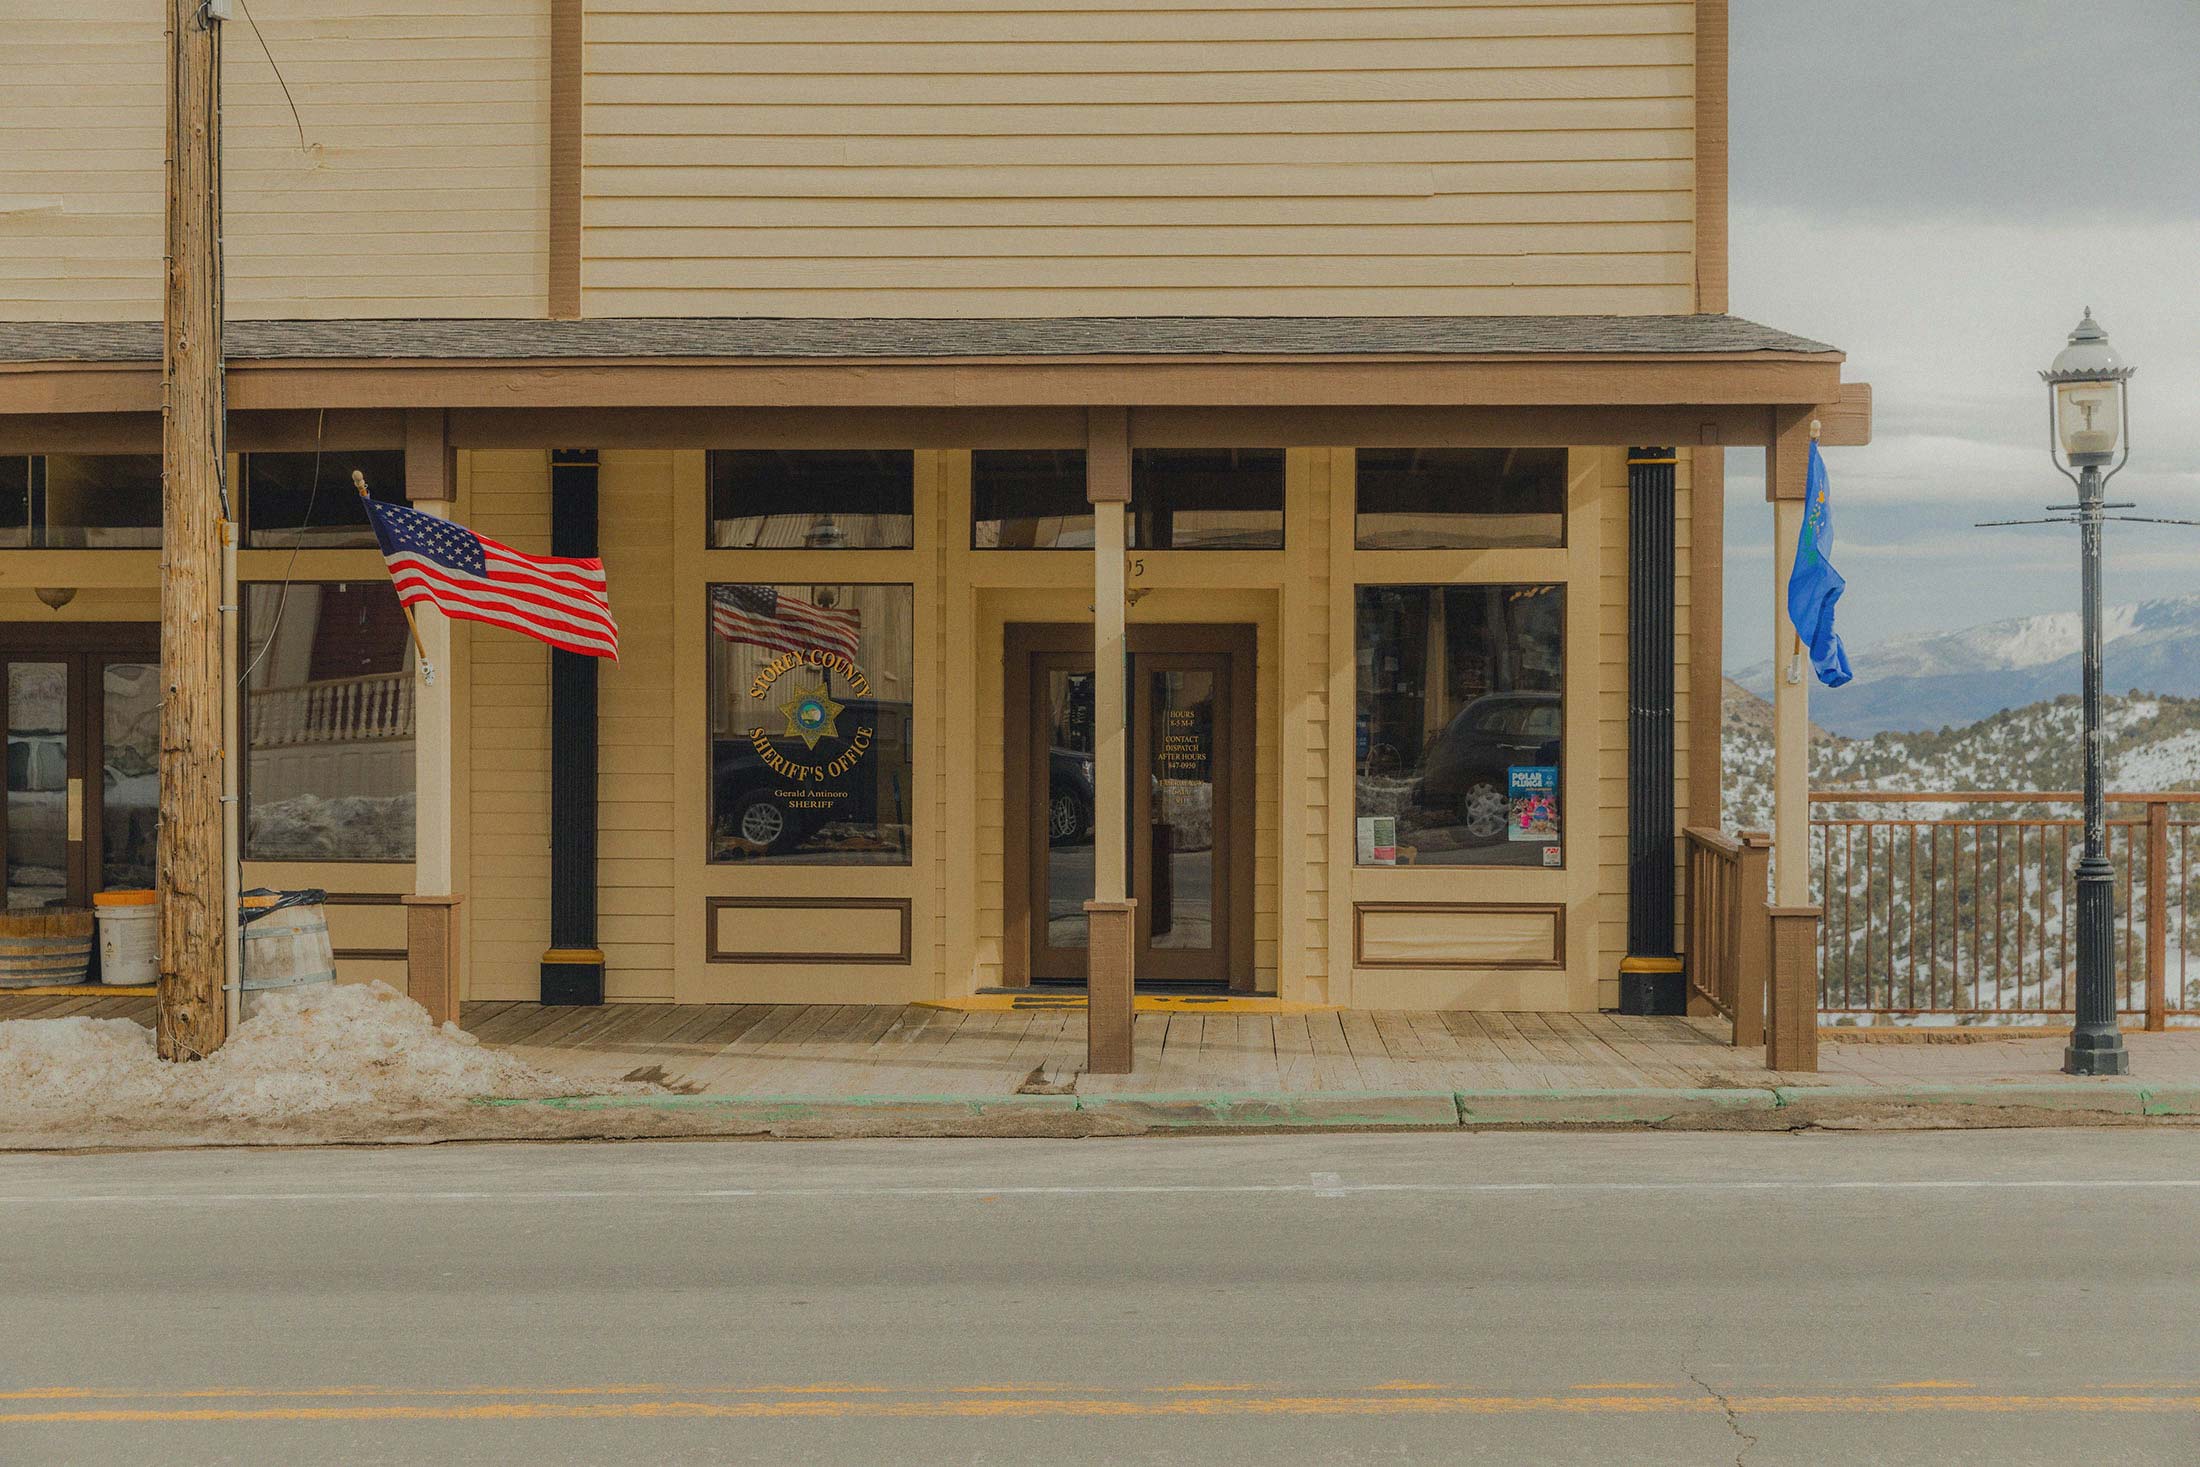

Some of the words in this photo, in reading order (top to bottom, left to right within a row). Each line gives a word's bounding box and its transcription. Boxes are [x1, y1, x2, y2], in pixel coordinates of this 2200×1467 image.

[1127, 559, 1144, 577] 5
[749, 648, 807, 700] STOREY
[810, 649, 873, 698] COUNTY
[749, 726, 825, 782] SHERIFF'S
[828, 726, 874, 778] OFFICE
[1512, 772, 1542, 781] POLAR
[1512, 779, 1543, 787] PLUNGE
[774, 789, 806, 798] Gerald
[807, 789, 848, 798] Antinoro
[788, 801, 834, 809] SHERIFF
